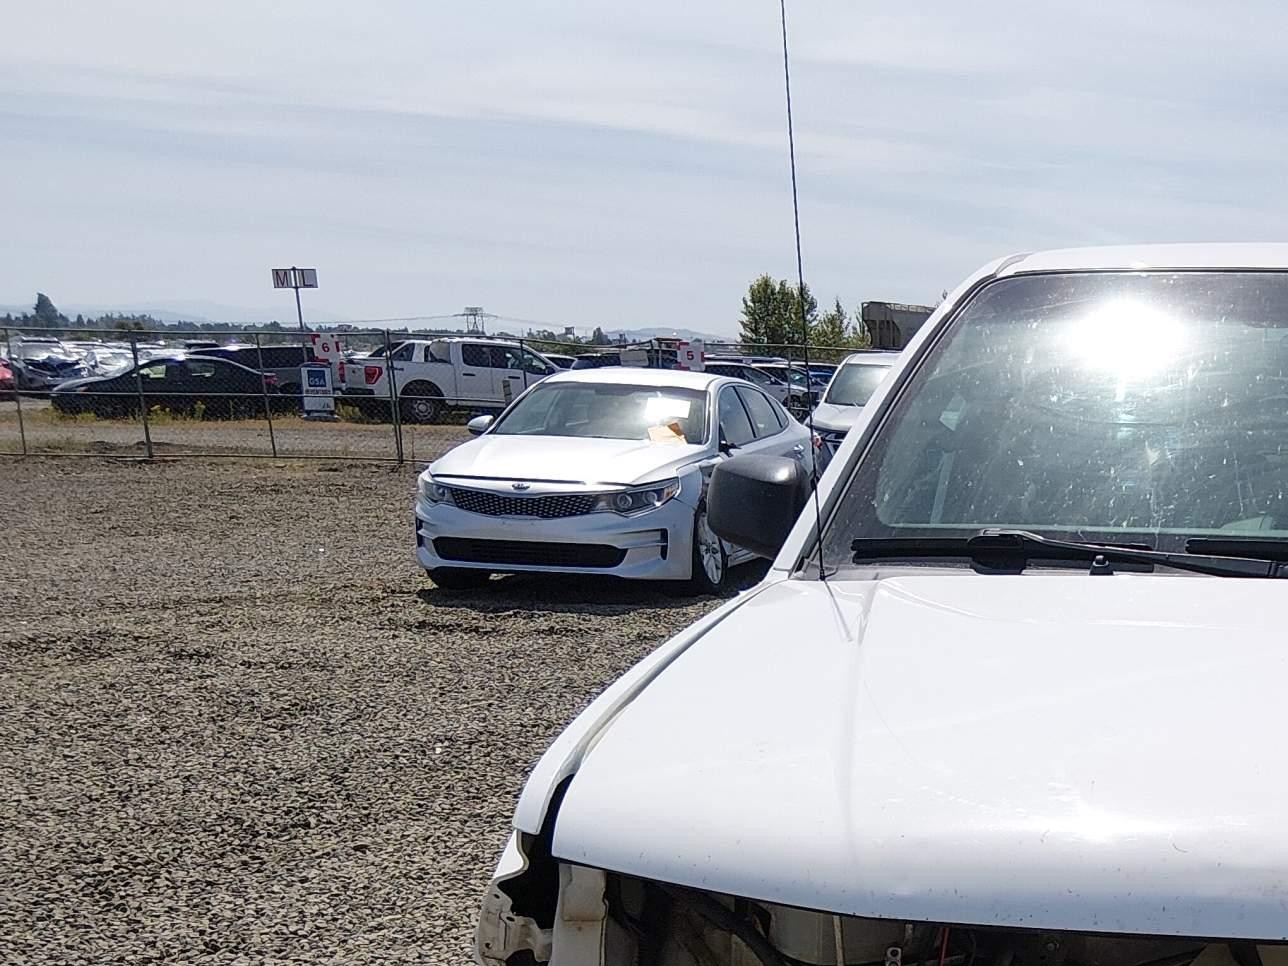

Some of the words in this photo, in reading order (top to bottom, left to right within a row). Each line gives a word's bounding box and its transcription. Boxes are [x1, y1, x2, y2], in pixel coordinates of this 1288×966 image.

[275, 271, 289, 287] M
[301, 270, 314, 287] L
[321, 342, 330, 353] 6
[309, 377, 325, 386] GSA
